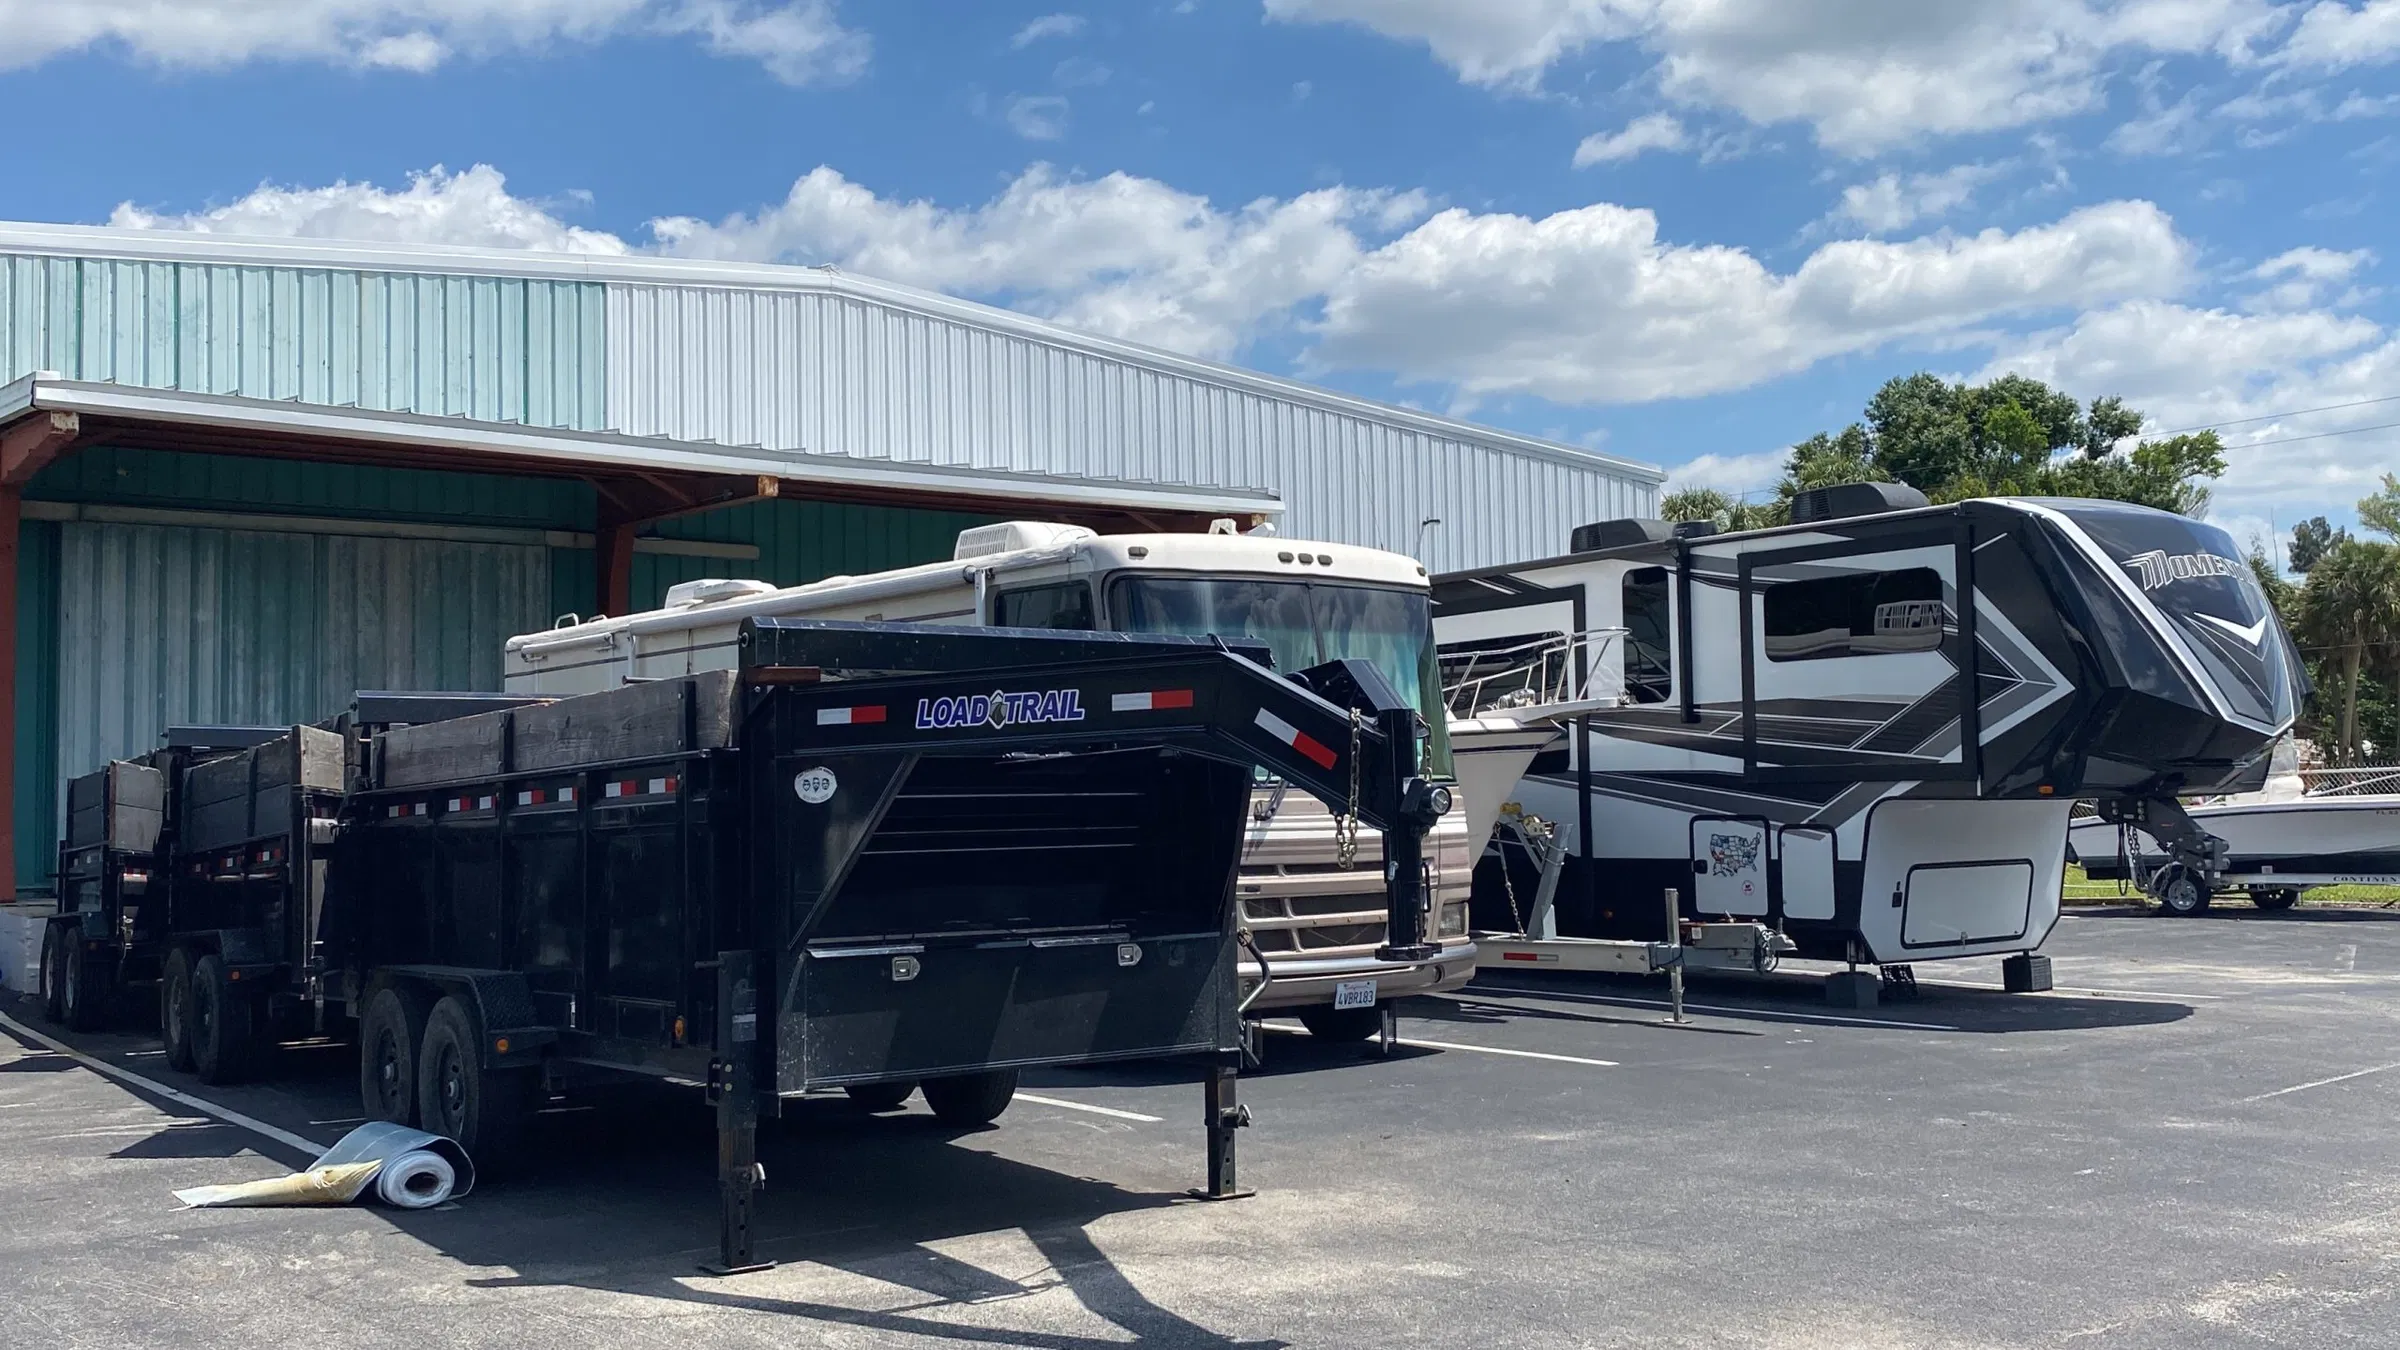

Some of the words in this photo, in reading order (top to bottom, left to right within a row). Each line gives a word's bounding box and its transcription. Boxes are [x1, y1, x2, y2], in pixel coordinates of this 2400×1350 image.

[2120, 549, 2255, 591] MOMENT
[915, 695, 991, 729] LOAD
[1003, 689, 1085, 724] TRAIL
[1338, 990, 1374, 1006] 4VBR183
